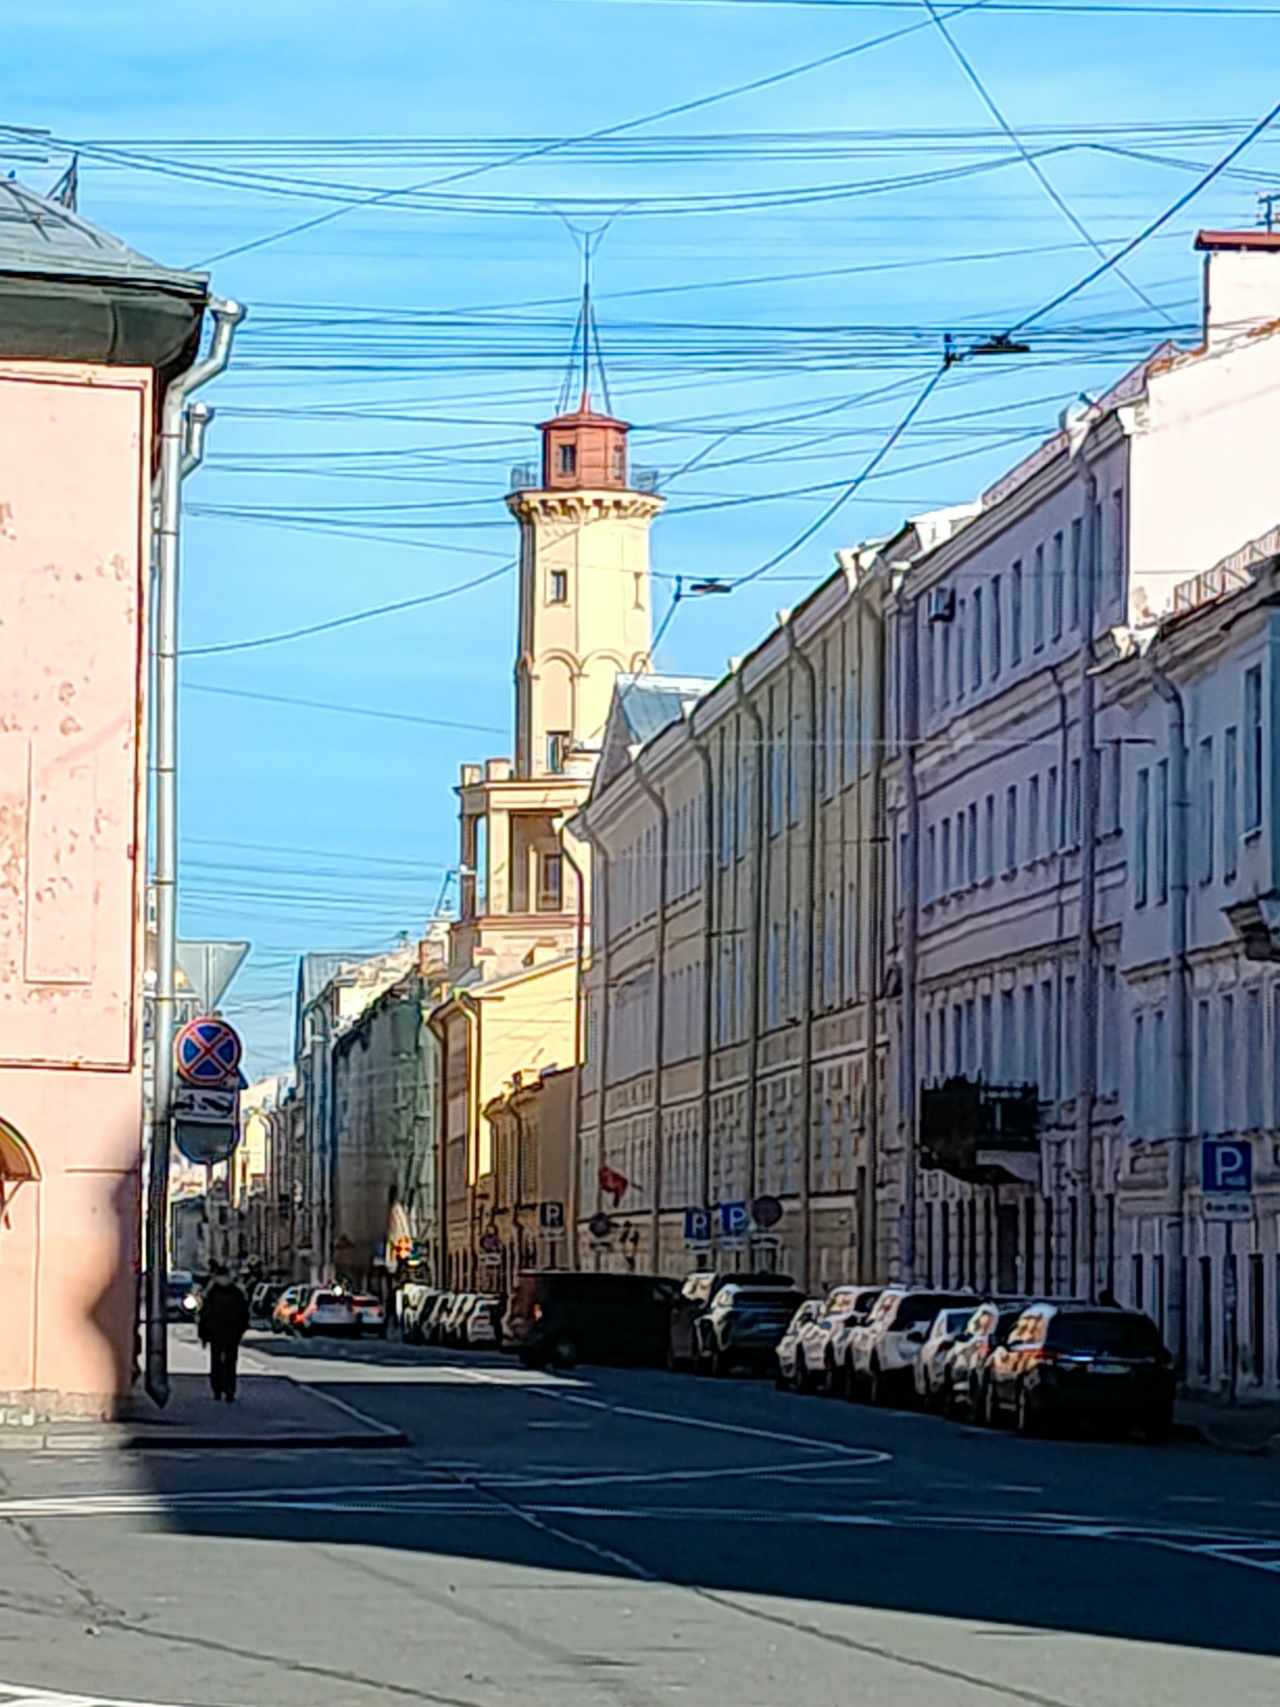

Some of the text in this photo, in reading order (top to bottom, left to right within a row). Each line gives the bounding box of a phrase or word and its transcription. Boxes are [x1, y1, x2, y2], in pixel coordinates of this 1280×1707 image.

[1215, 1146, 1243, 1186] P
[692, 1213, 707, 1236] P
[730, 1207, 746, 1230] P
